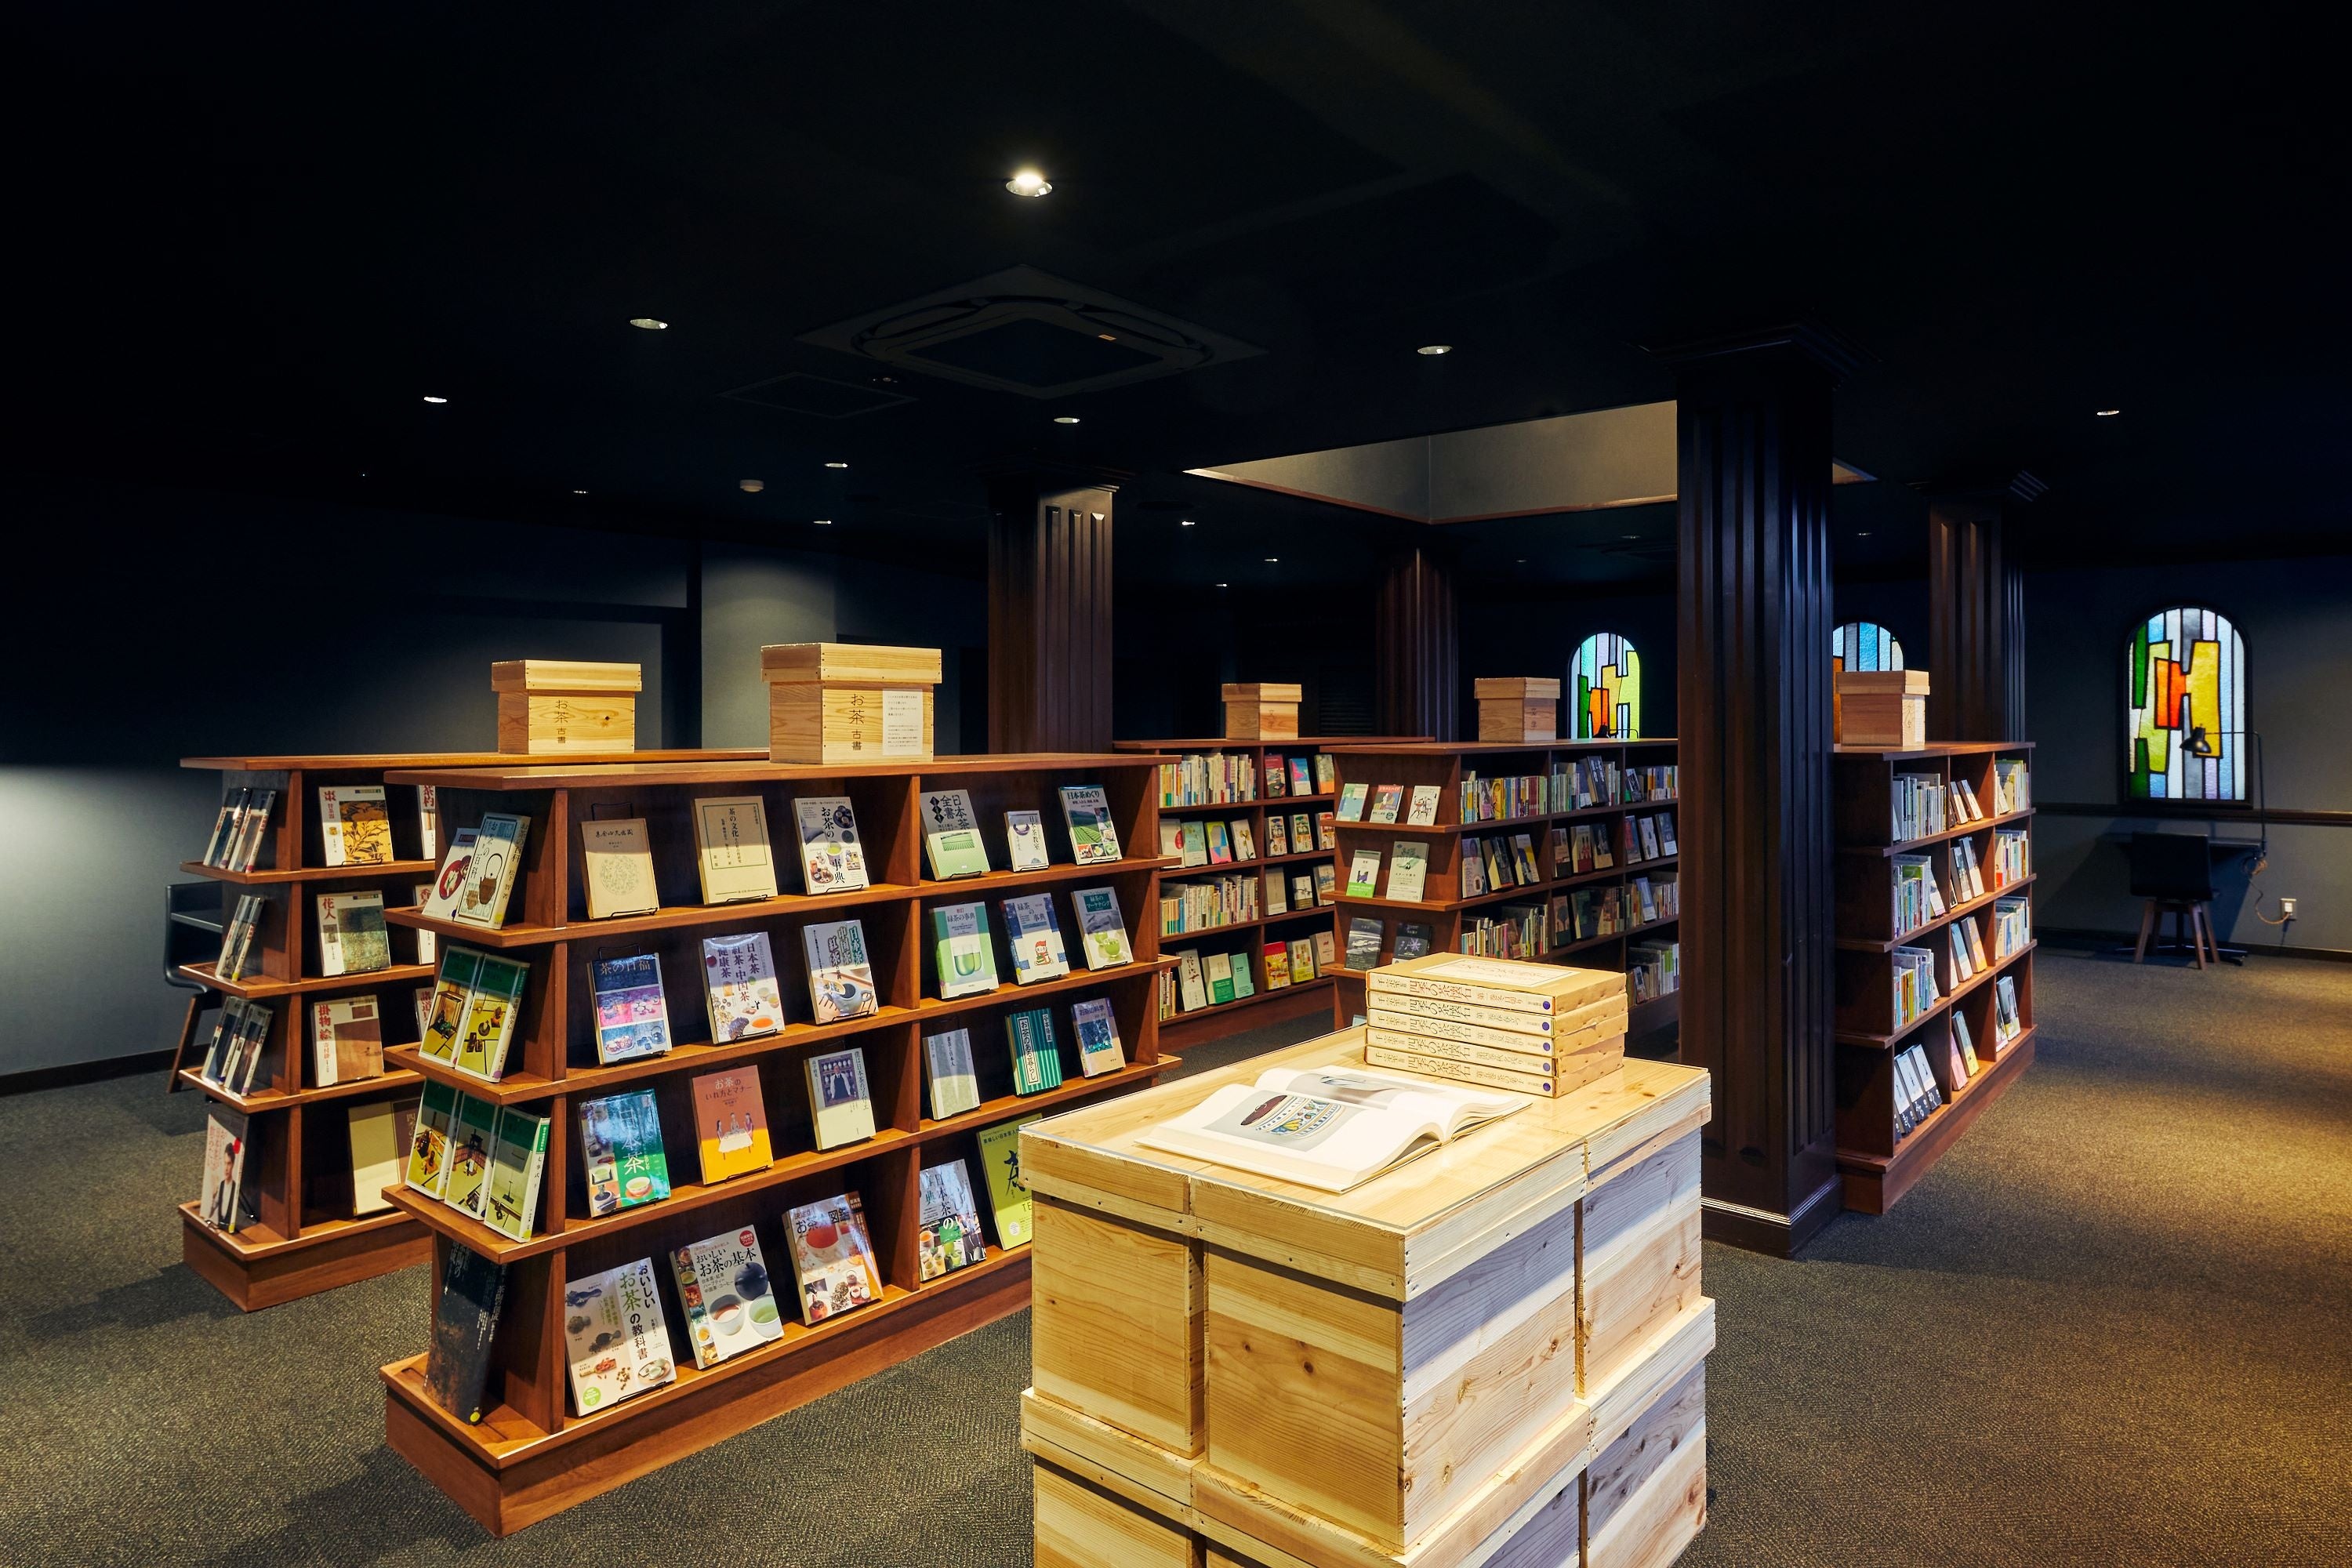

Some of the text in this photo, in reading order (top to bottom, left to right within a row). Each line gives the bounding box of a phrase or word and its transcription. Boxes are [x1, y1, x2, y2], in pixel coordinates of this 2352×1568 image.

[553, 699, 569, 743] お茶古書
[848, 694, 865, 750] お茶古書
[940, 795, 954, 819] 全書
[1067, 790, 1100, 800] 日本茶めぐり
[729, 808, 739, 837] 茶の文化
[952, 794, 971, 830] 日本茶
[947, 913, 975, 923] 緑茶の事典
[746, 943, 760, 975] 日本茶
[828, 935, 840, 967] 紅茶
[837, 927, 851, 966] 中国茶
[849, 926, 863, 966] 日本茶
[1021, 1021, 1036, 1080] お茶のある暮らし
[706, 1086, 753, 1100] いれ方とマナー
[715, 1076, 741, 1090] お茶の
[619, 1109, 644, 1175] 日本茶
[697, 1249, 726, 1263] おいしい
[700, 1248, 757, 1277] お茶の基本
[638, 1265, 655, 1308] おいしい
[620, 1272, 648, 1360] お茶の教科書
